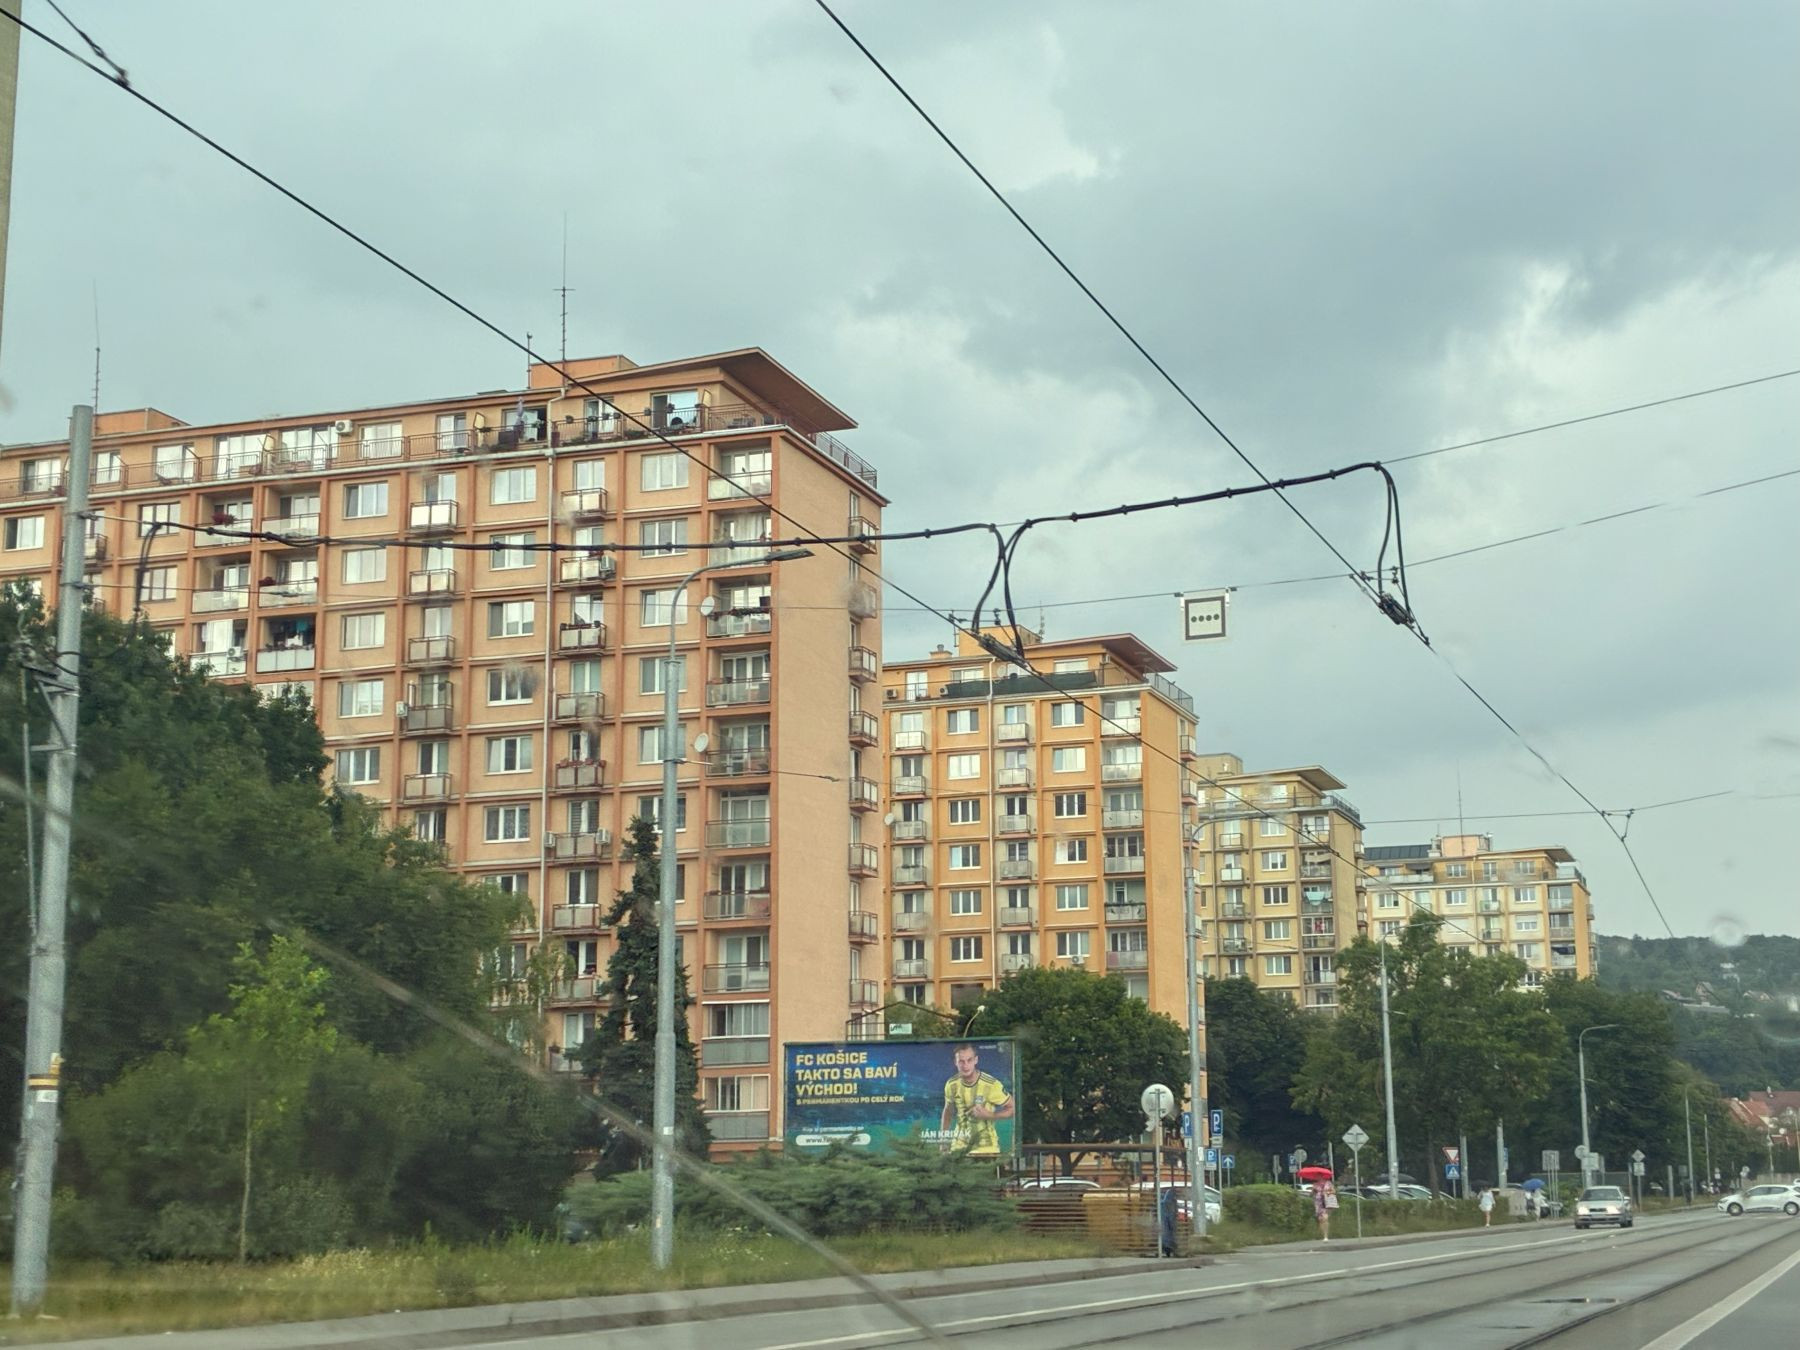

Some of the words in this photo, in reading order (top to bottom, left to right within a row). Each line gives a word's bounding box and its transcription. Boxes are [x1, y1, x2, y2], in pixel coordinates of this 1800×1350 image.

[796, 1054, 813, 1066] FC
[817, 1050, 867, 1065] KOŠICE
[796, 1069, 840, 1081] TAKTO
[843, 1068, 862, 1079] SA
[865, 1062, 897, 1078] BAVÍ
[796, 1081, 857, 1095] VÝCHOD!
[871, 1094, 888, 1103] CELÝ
